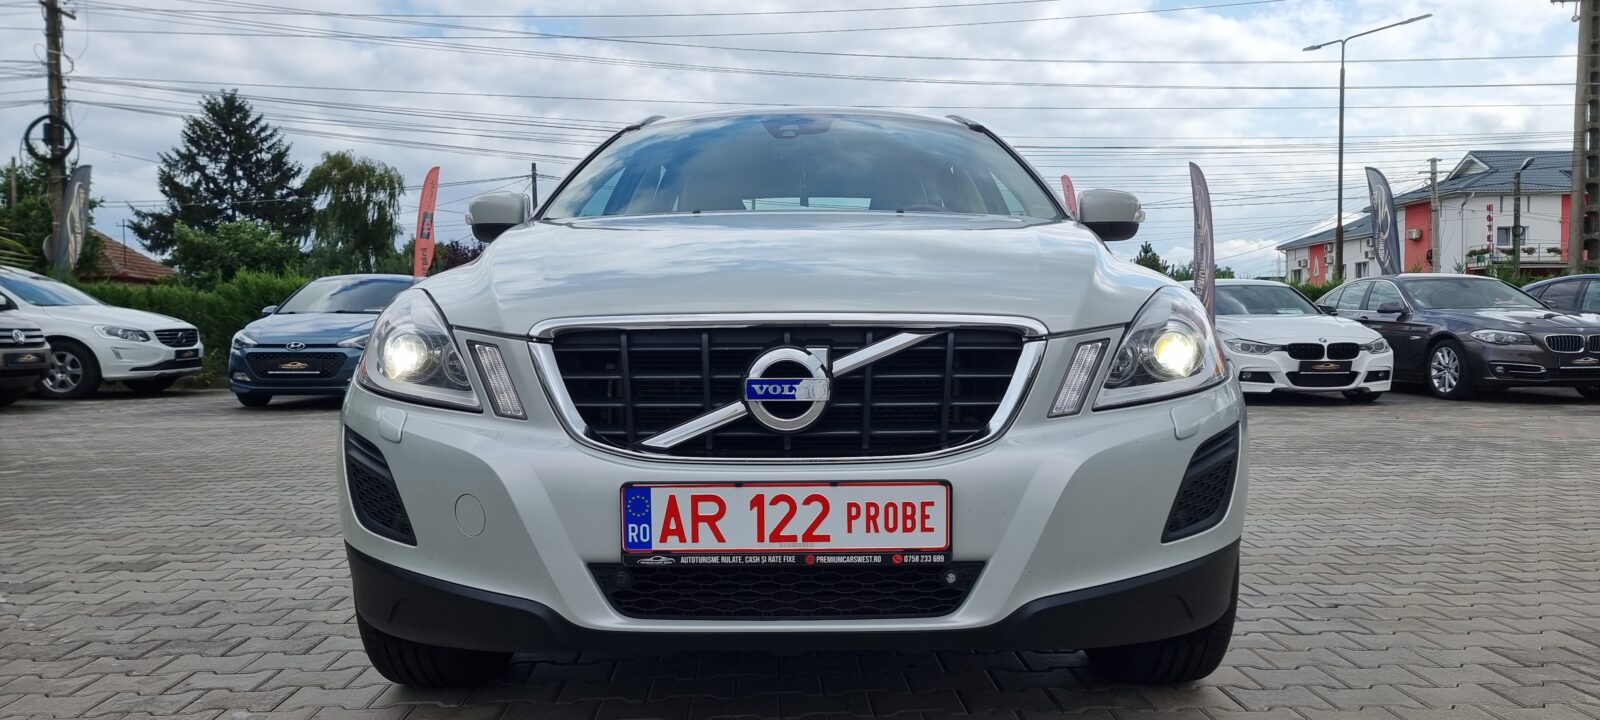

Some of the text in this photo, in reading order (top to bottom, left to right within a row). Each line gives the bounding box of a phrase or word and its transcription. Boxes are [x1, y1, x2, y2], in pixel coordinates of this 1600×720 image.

[658, 492, 935, 544] AR 122 PROBE
[628, 523, 650, 543] RO
[680, 556, 720, 564] AUTOTURISME
[720, 555, 744, 564] RULATE,
[744, 555, 760, 563] CASH
[767, 555, 782, 563] RATE
[783, 555, 796, 563] FIXE
[816, 555, 882, 564] PREMIUMCARSWEST.RO
[920, 554, 932, 563] 233
[933, 554, 945, 563] 699
